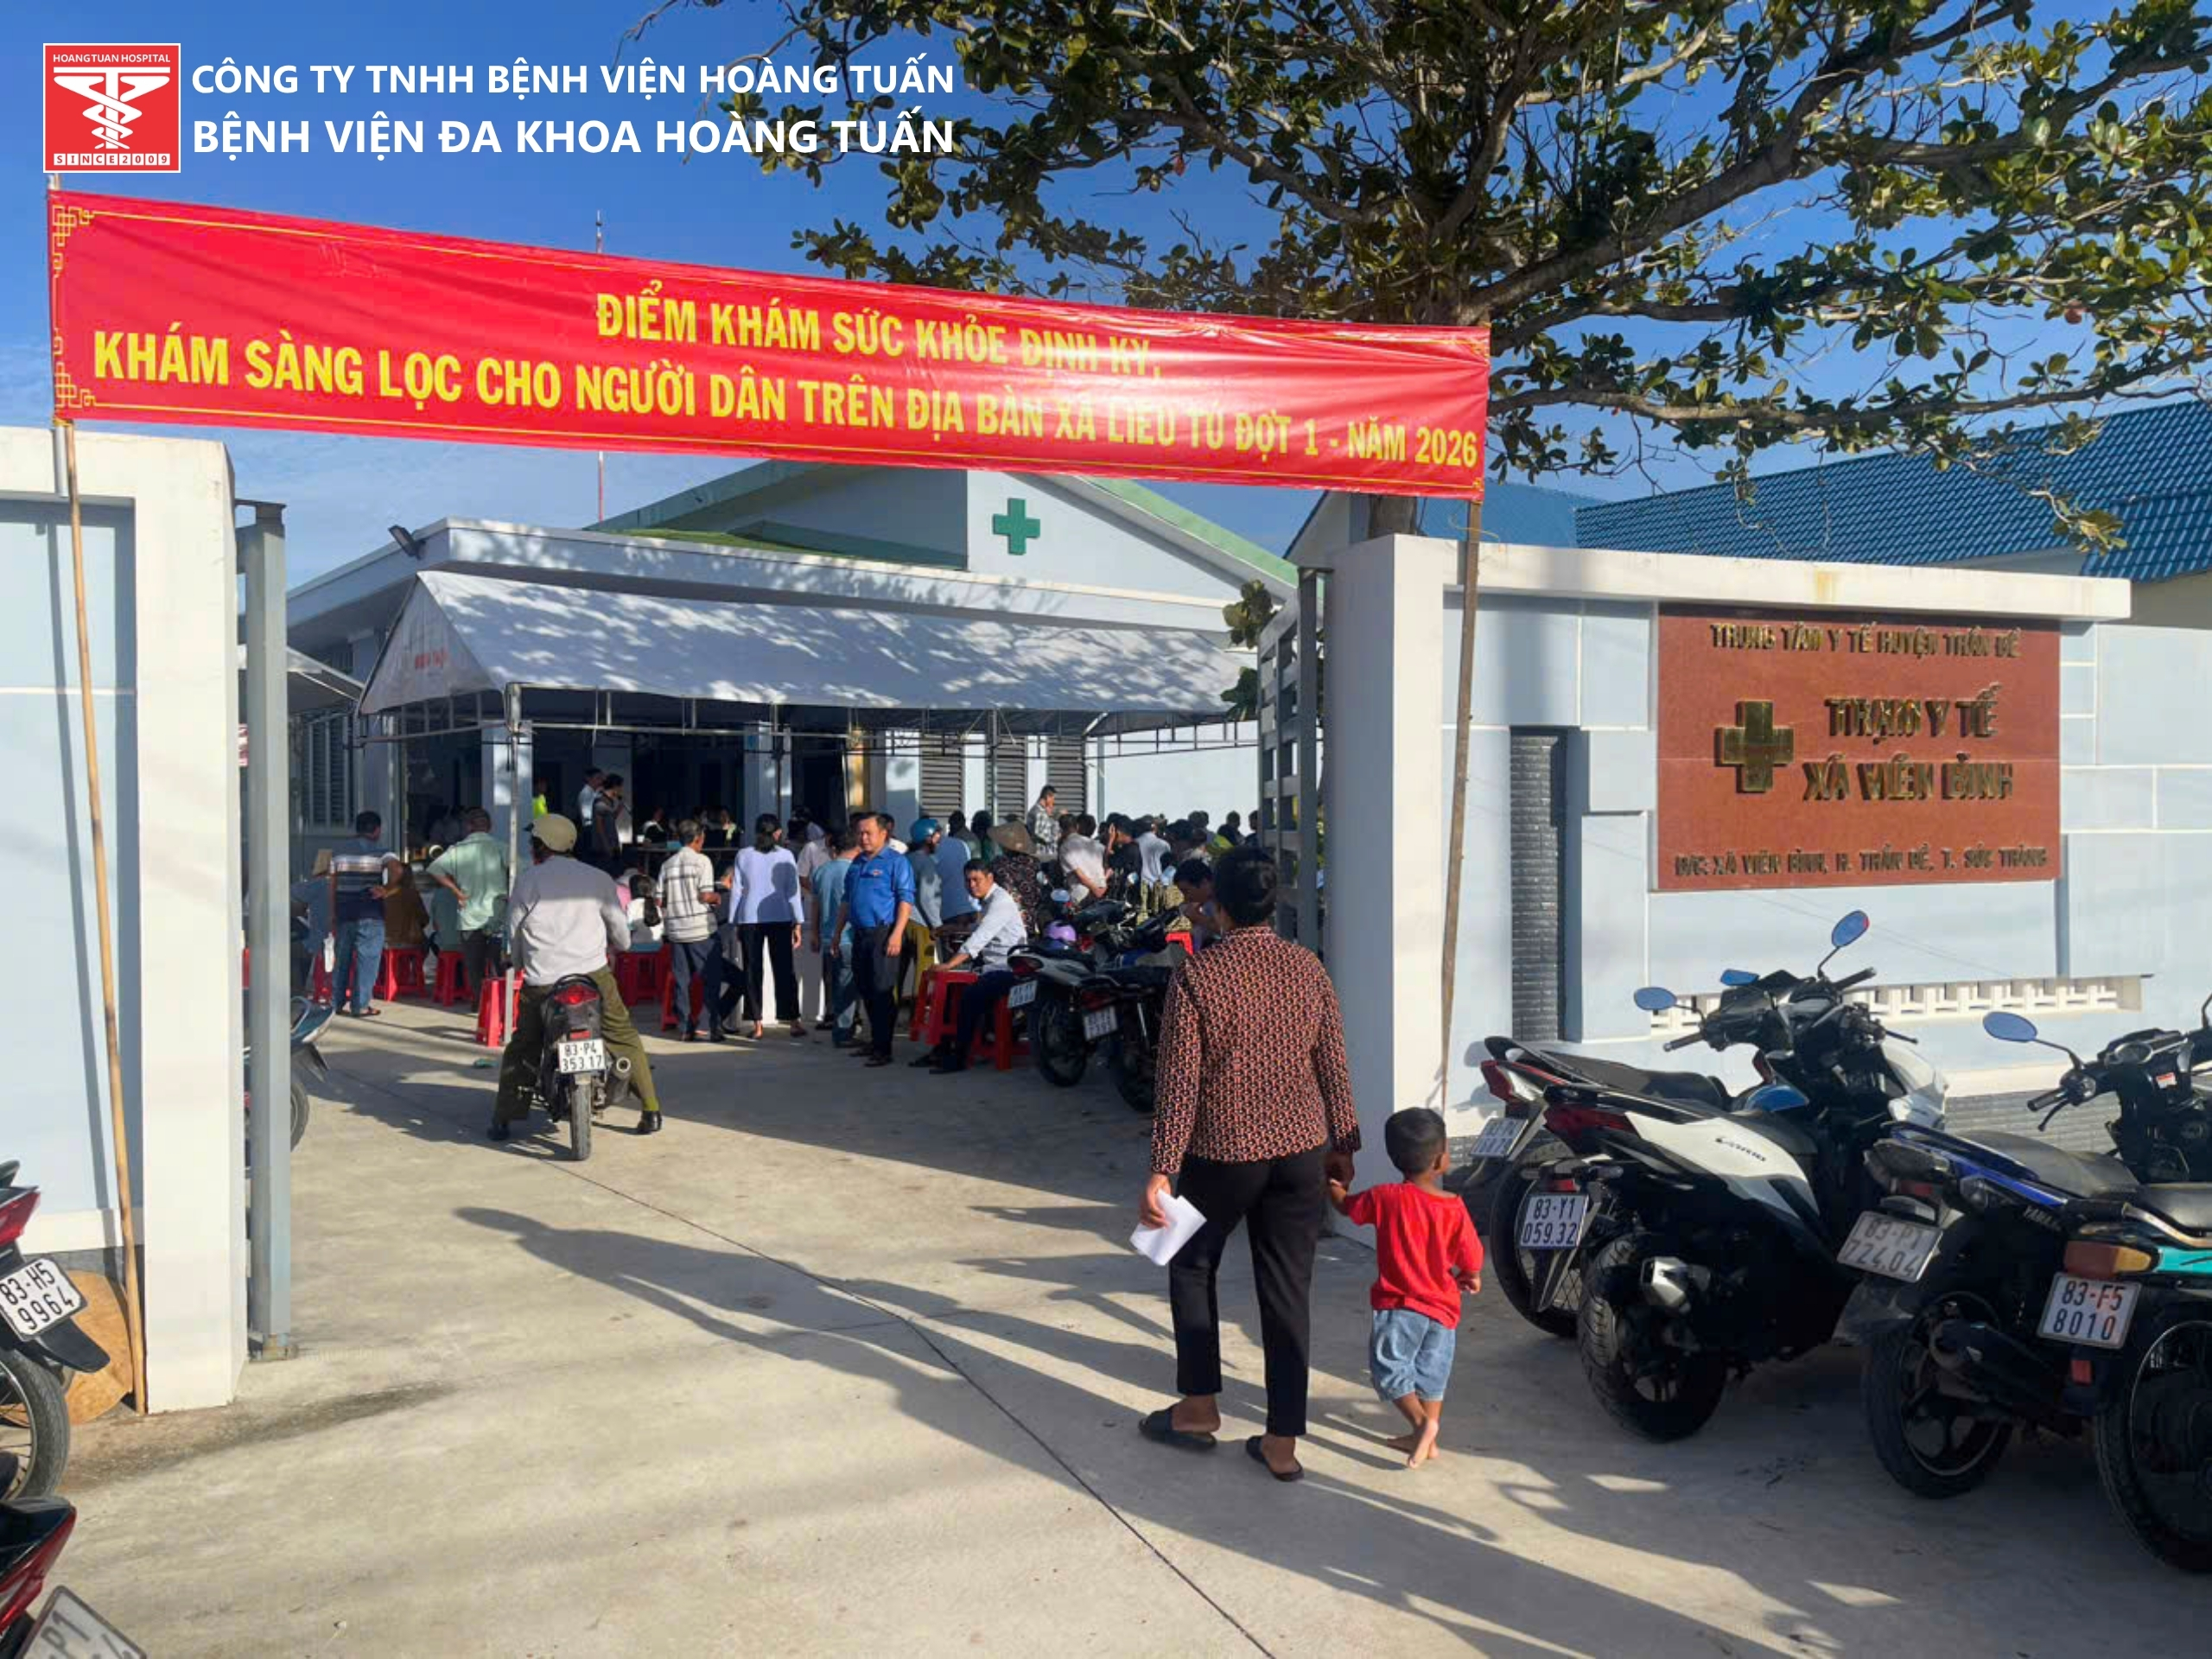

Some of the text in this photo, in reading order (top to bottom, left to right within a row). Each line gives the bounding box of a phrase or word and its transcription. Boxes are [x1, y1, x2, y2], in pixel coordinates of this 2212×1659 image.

[597, 280, 696, 343] ĐIỂM
[711, 297, 821, 351] KHÁM
[832, 307, 903, 358] SỨC
[916, 314, 1008, 364] KHỎE
[1019, 327, 1097, 378] ĐỊNH
[94, 322, 228, 385] KHÁM
[245, 330, 363, 395] SÀNG
[379, 350, 461, 410] LỌC
[477, 357, 561, 409] CHO
[576, 359, 696, 416] NGƯỜI
[710, 365, 786, 422] DÂN
[798, 374, 893, 429] TRÊN
[906, 388, 964, 441] ĐỊA
[977, 385, 1044, 437] BÀN
[1235, 409, 1291, 461] ĐỢT
[1304, 418, 1319, 455] 1
[1348, 416, 1406, 461] NĂM
[1414, 429, 1478, 468] 2026
[1710, 623, 1777, 650] TRUNG
[1827, 628, 1843, 652] Y
[1824, 682, 2002, 745] TRẠM Y TẾ
[1802, 751, 1851, 801] XÃ
[1856, 750, 1934, 800] VIÊN
[1522, 1222, 1577, 1244] 059.32
[17, 1286, 74, 1330] 9964
[2062, 1281, 2126, 1311] 83-F5
[2053, 1308, 2116, 1340] 8010
